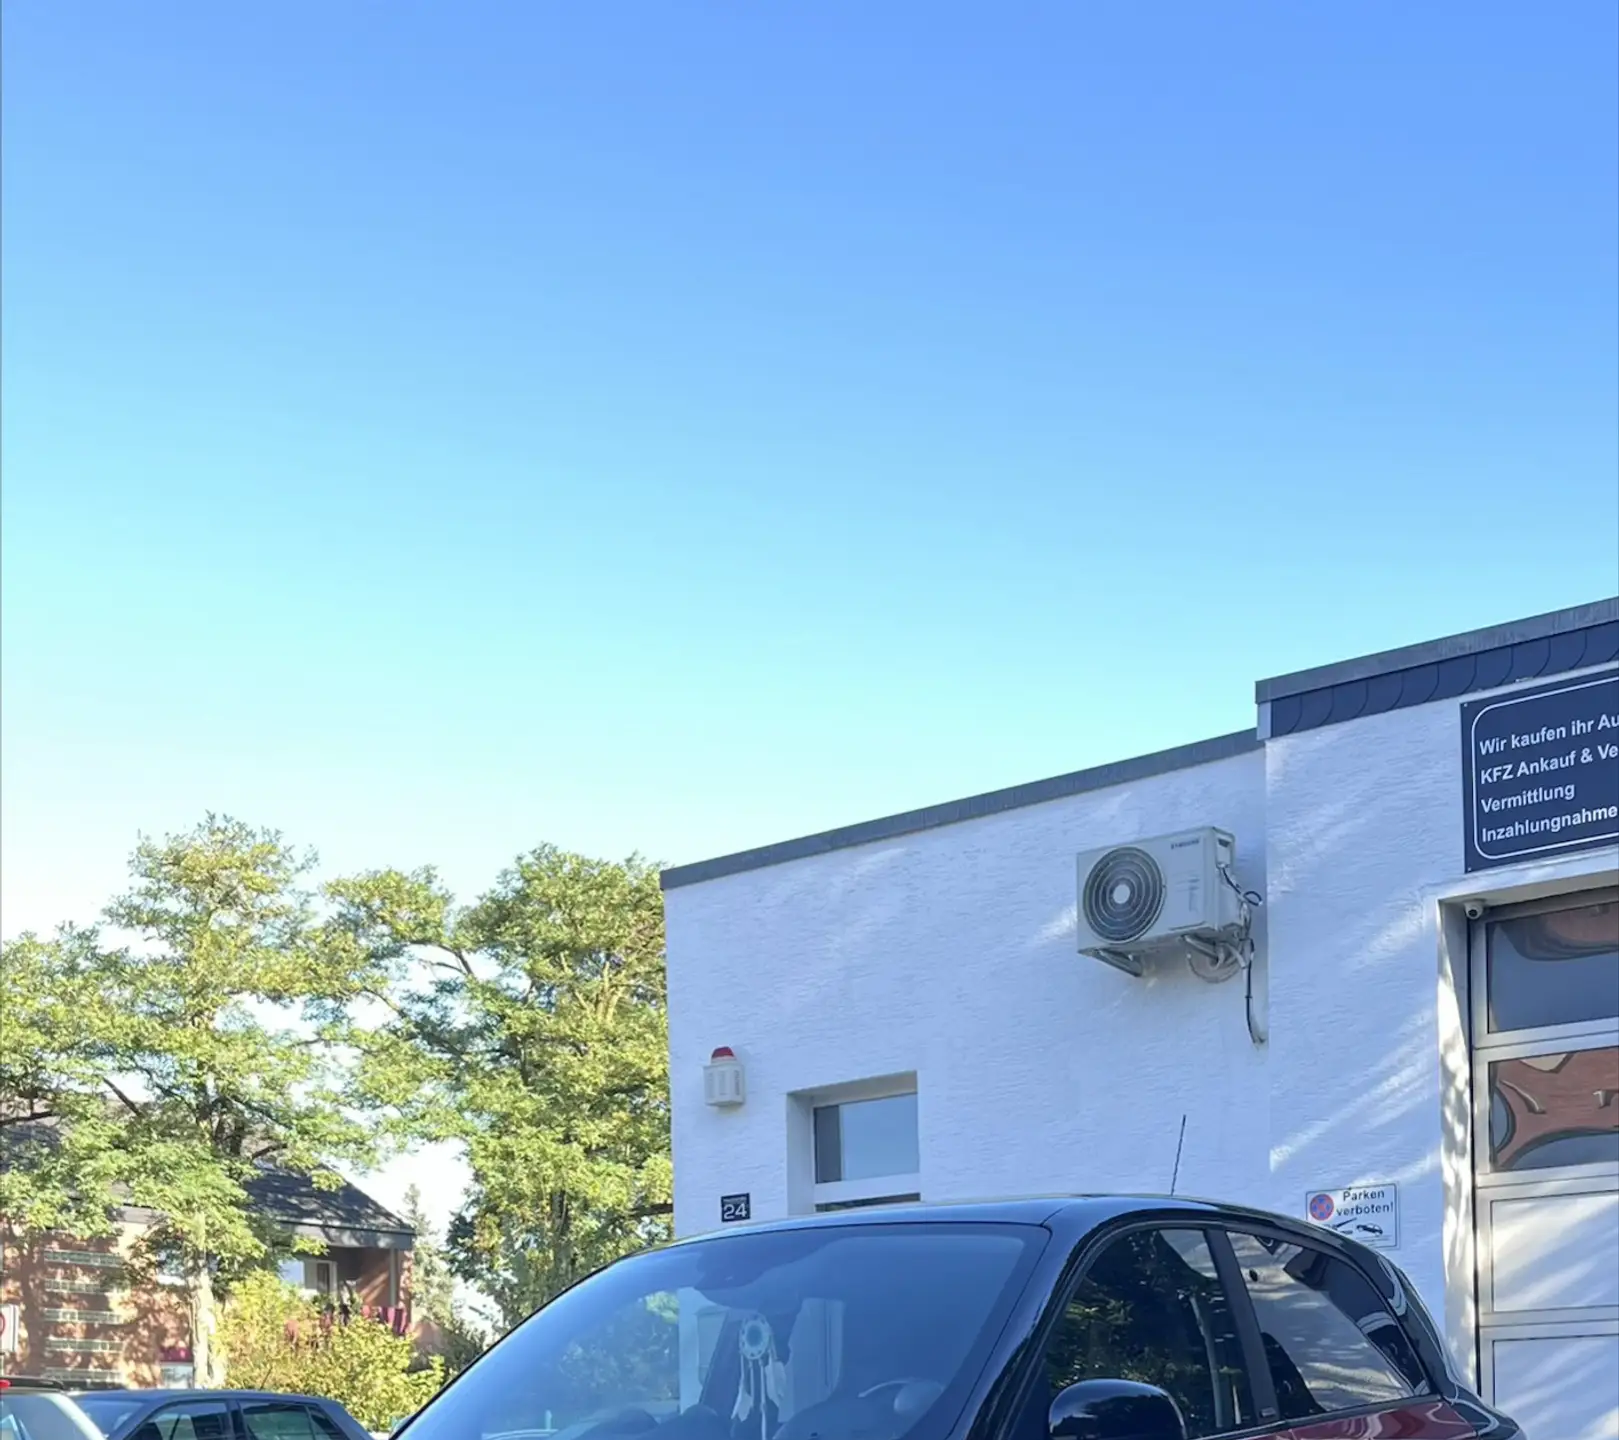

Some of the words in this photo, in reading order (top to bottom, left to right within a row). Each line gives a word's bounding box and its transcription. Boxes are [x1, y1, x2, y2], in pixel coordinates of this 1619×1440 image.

[1479, 738, 1507, 756] Wir
[1511, 726, 1567, 749] kaufen
[1571, 720, 1594, 736] ihr
[1481, 764, 1514, 784] KFZ
[1517, 750, 1577, 777] Ankauf
[1580, 748, 1593, 763] &
[1481, 784, 1575, 813] Vermittlung
[1482, 805, 1618, 842] Inzahlungnahme
[1336, 1201, 1394, 1216] verboten!
[1343, 1190, 1385, 1201] Parken
[723, 1203, 748, 1219] 24
